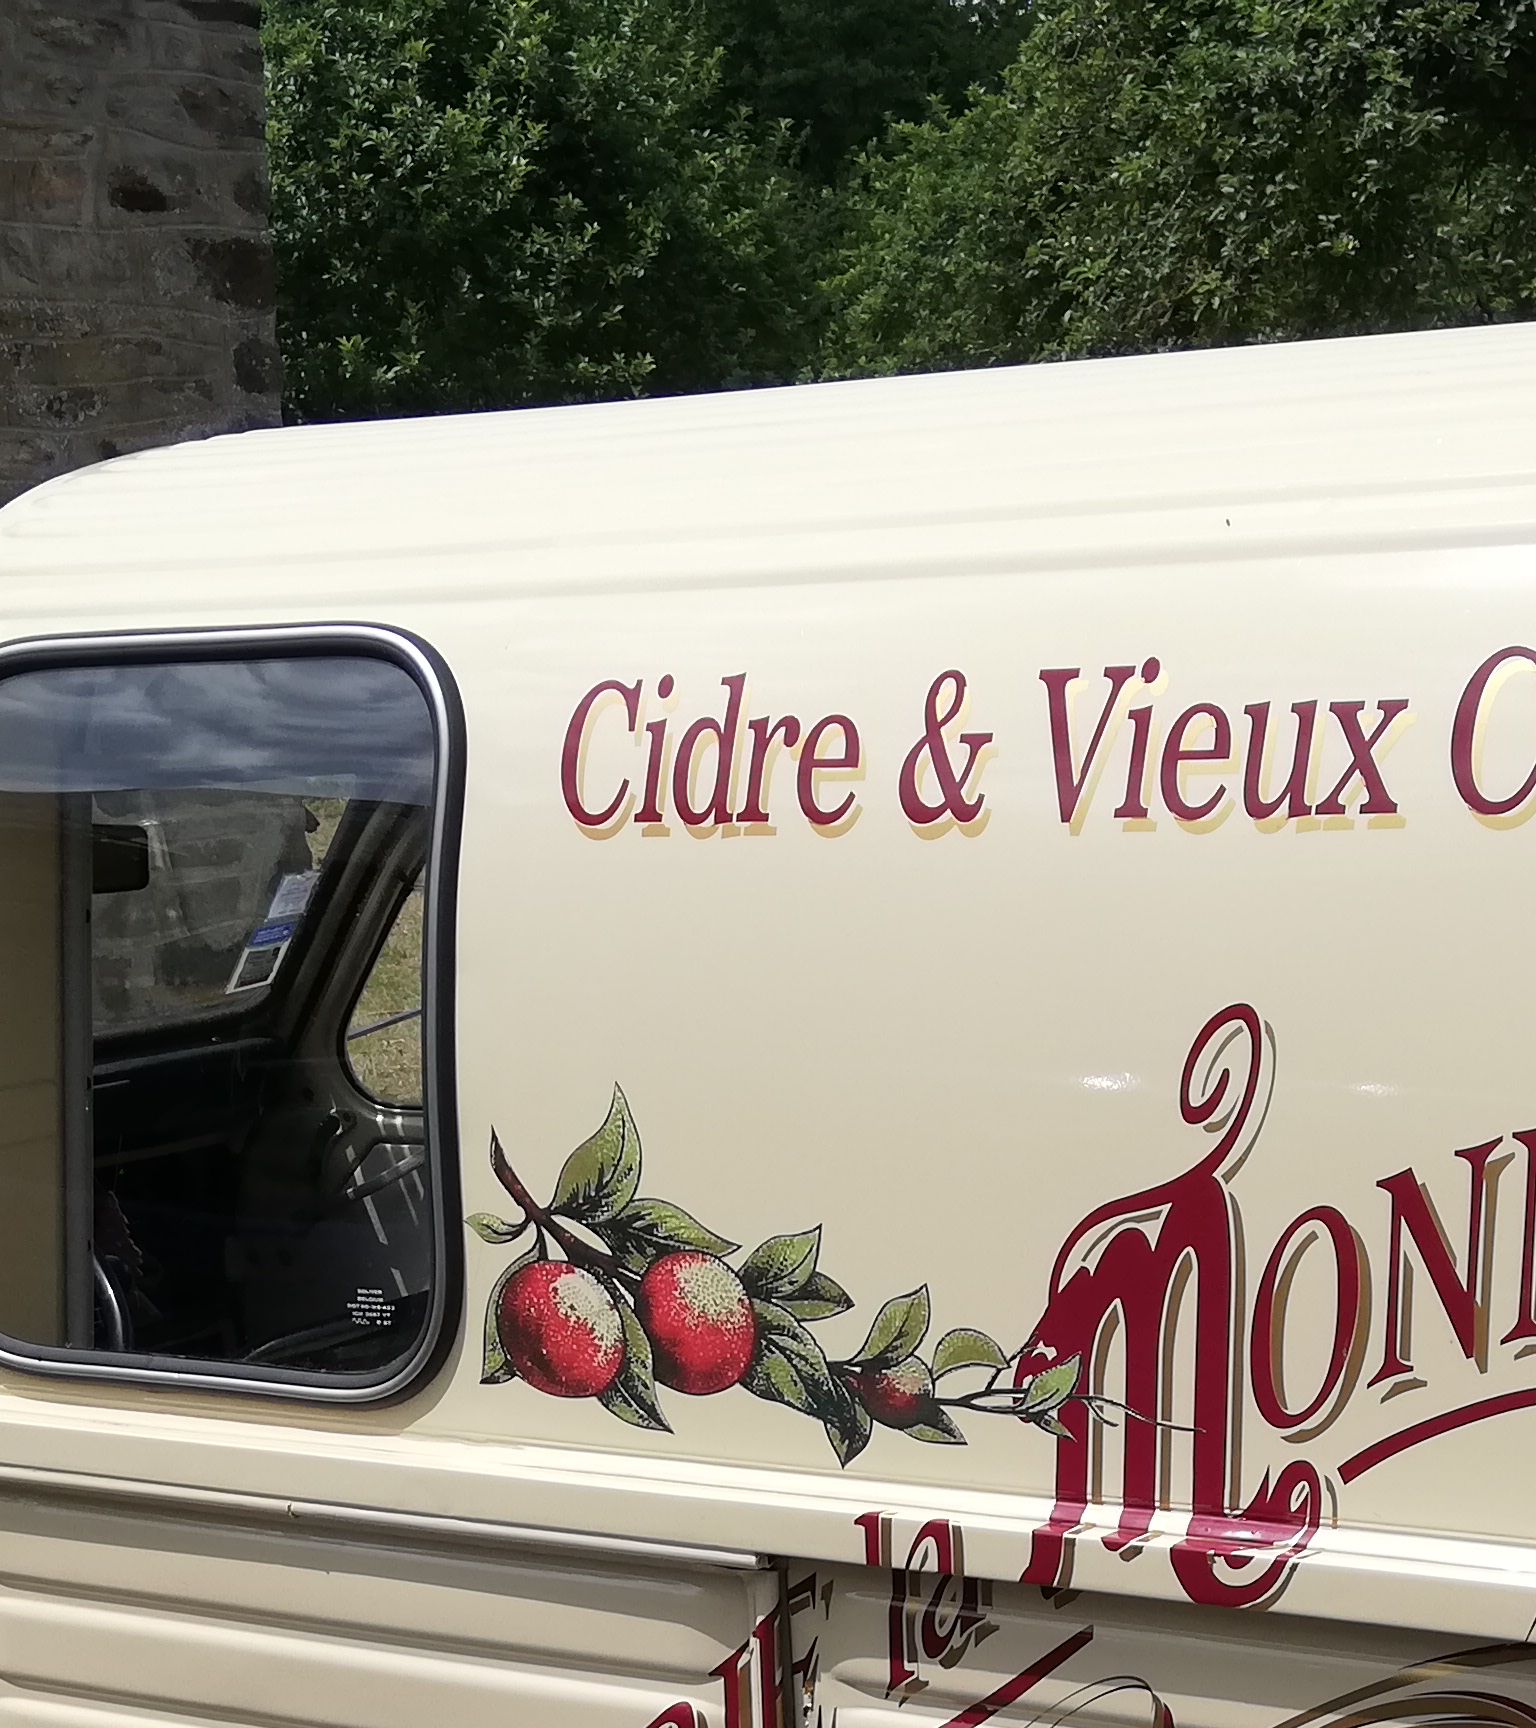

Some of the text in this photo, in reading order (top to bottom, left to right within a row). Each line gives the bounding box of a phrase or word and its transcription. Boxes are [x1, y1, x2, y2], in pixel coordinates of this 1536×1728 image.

[560, 672, 868, 842] Cidre
[898, 668, 994, 842] &
[1039, 655, 1412, 834] Vieux
[854, 1510, 999, 1705] la
